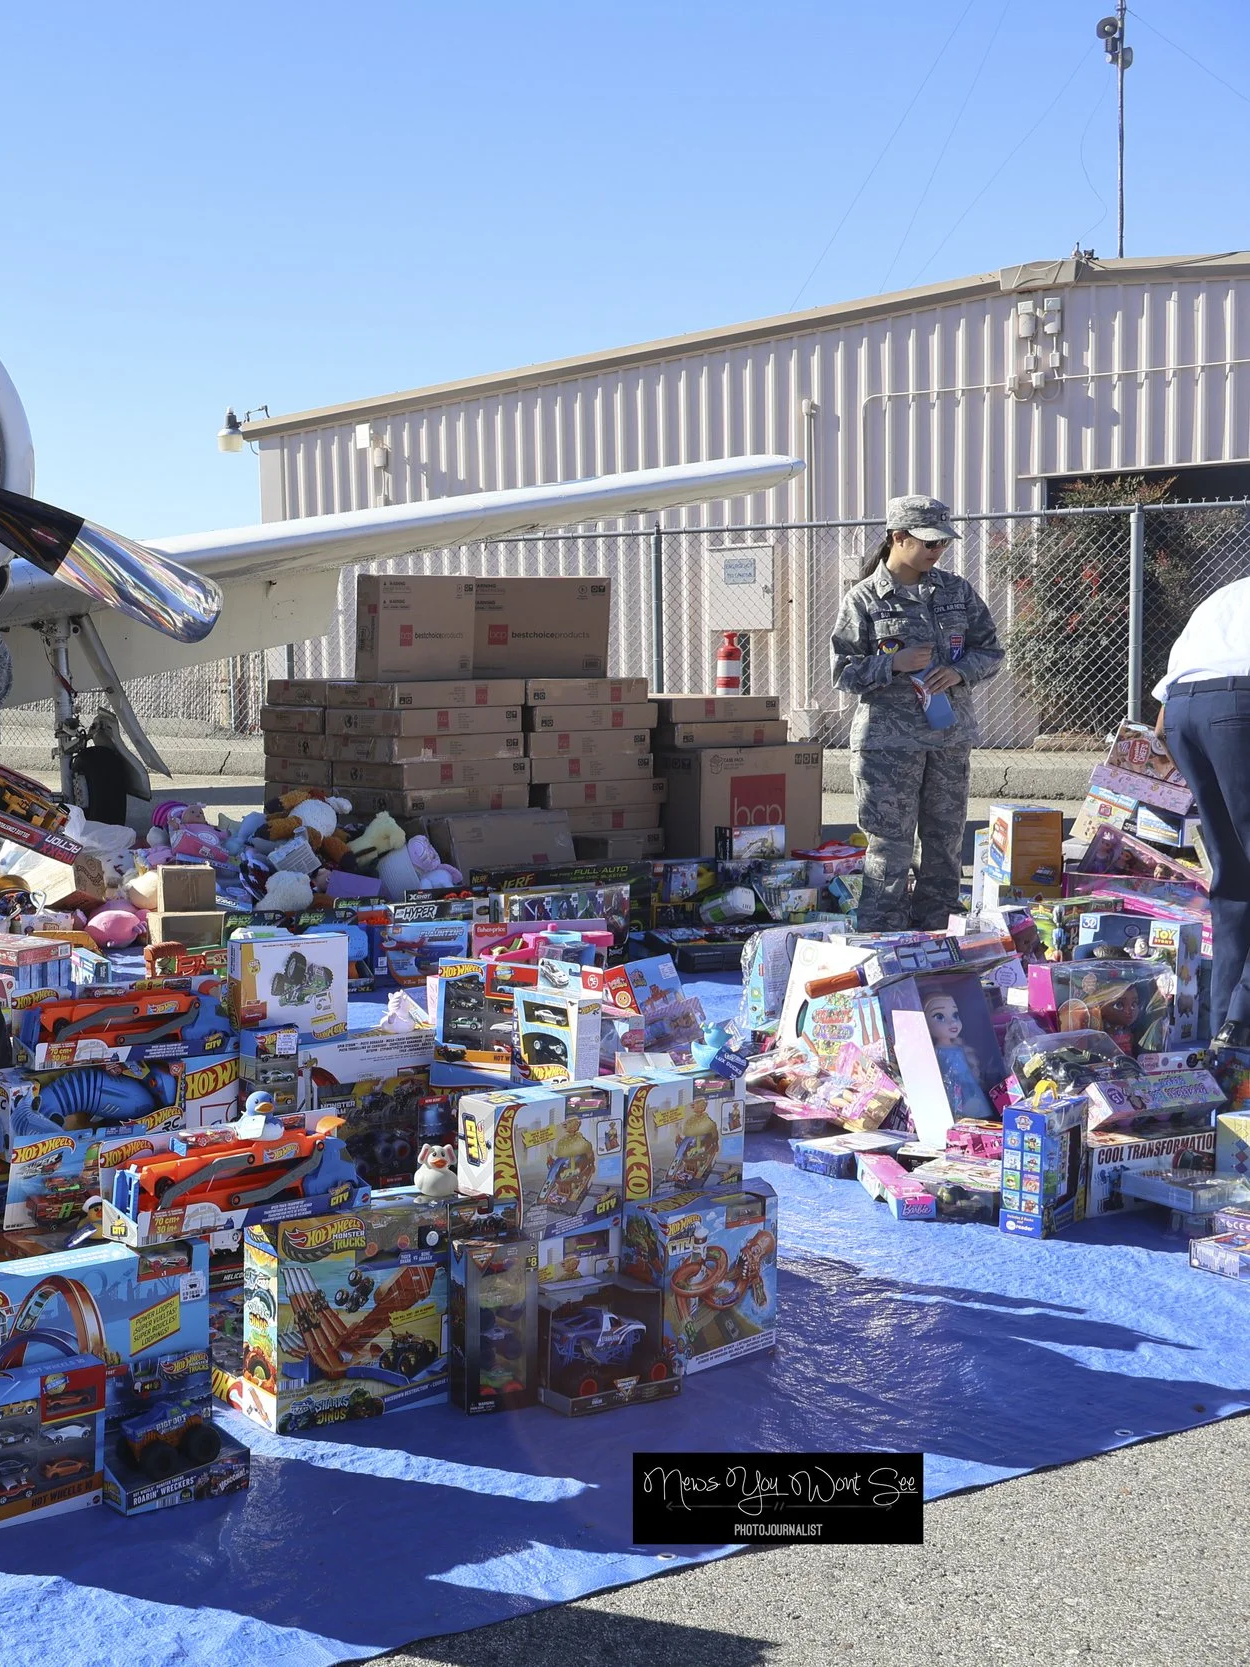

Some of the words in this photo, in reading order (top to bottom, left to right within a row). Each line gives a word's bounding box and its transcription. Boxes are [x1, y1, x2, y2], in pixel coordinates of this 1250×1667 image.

[414, 631, 464, 640] bestchoiceproducts
[511, 630, 590, 640] bestchoiceproducts
[403, 904, 435, 921] HYPER
[1152, 928, 1178, 940] TOY
[205, 1039, 222, 1050] CITY
[714, 1054, 726, 1065] LUX
[726, 1060, 743, 1075] DUCKS
[186, 1068, 216, 1098] HOT
[162, 1118, 181, 1132] RC
[15, 1145, 39, 1163] HOT
[38, 1136, 73, 1156] WHEELS
[105, 1148, 122, 1168] HOT
[121, 1139, 152, 1160] WHEELS
[1097, 1144, 1125, 1166] COOL
[330, 1193, 350, 1206] CITY
[596, 1198, 617, 1214] CITY
[901, 1202, 933, 1217] Barbie
[154, 1217, 164, 1226] 70
[165, 1216, 180, 1225] cm+
[111, 1226, 126, 1236] CITY
[156, 1226, 166, 1234] 30
[307, 1224, 332, 1247] HOT
[330, 1217, 361, 1236] WHEELS
[333, 1230, 365, 1239] MONSTER
[333, 1236, 366, 1250] TRUCKS
[472, 1252, 492, 1260] MONSTER
[528, 1256, 538, 1267] $8
[135, 1310, 156, 1325] POWER
[155, 1300, 175, 1316] LOOPS!
[133, 1321, 155, 1337] ¡SUPER
[153, 1308, 177, 1327] VUELTAS!
[133, 1328, 152, 1343] SUPER
[150, 1315, 177, 1336] BOUCLES!
[141, 1326, 170, 1346] LOOPINGS!
[172, 1356, 187, 1372] HOT
[189, 1364, 209, 1374] TRUCKS
[314, 1395, 351, 1411] SHARKS
[155, 1413, 187, 1431] BIGFOOT
[316, 1409, 347, 1423] DINOS
[31, 1495, 48, 1508] HOT
[49, 1482, 82, 1503] WHEELS
[84, 1479, 94, 1490] 10
[133, 1489, 159, 1506] ROARIN'
[160, 1476, 196, 1496] WRECKERS
